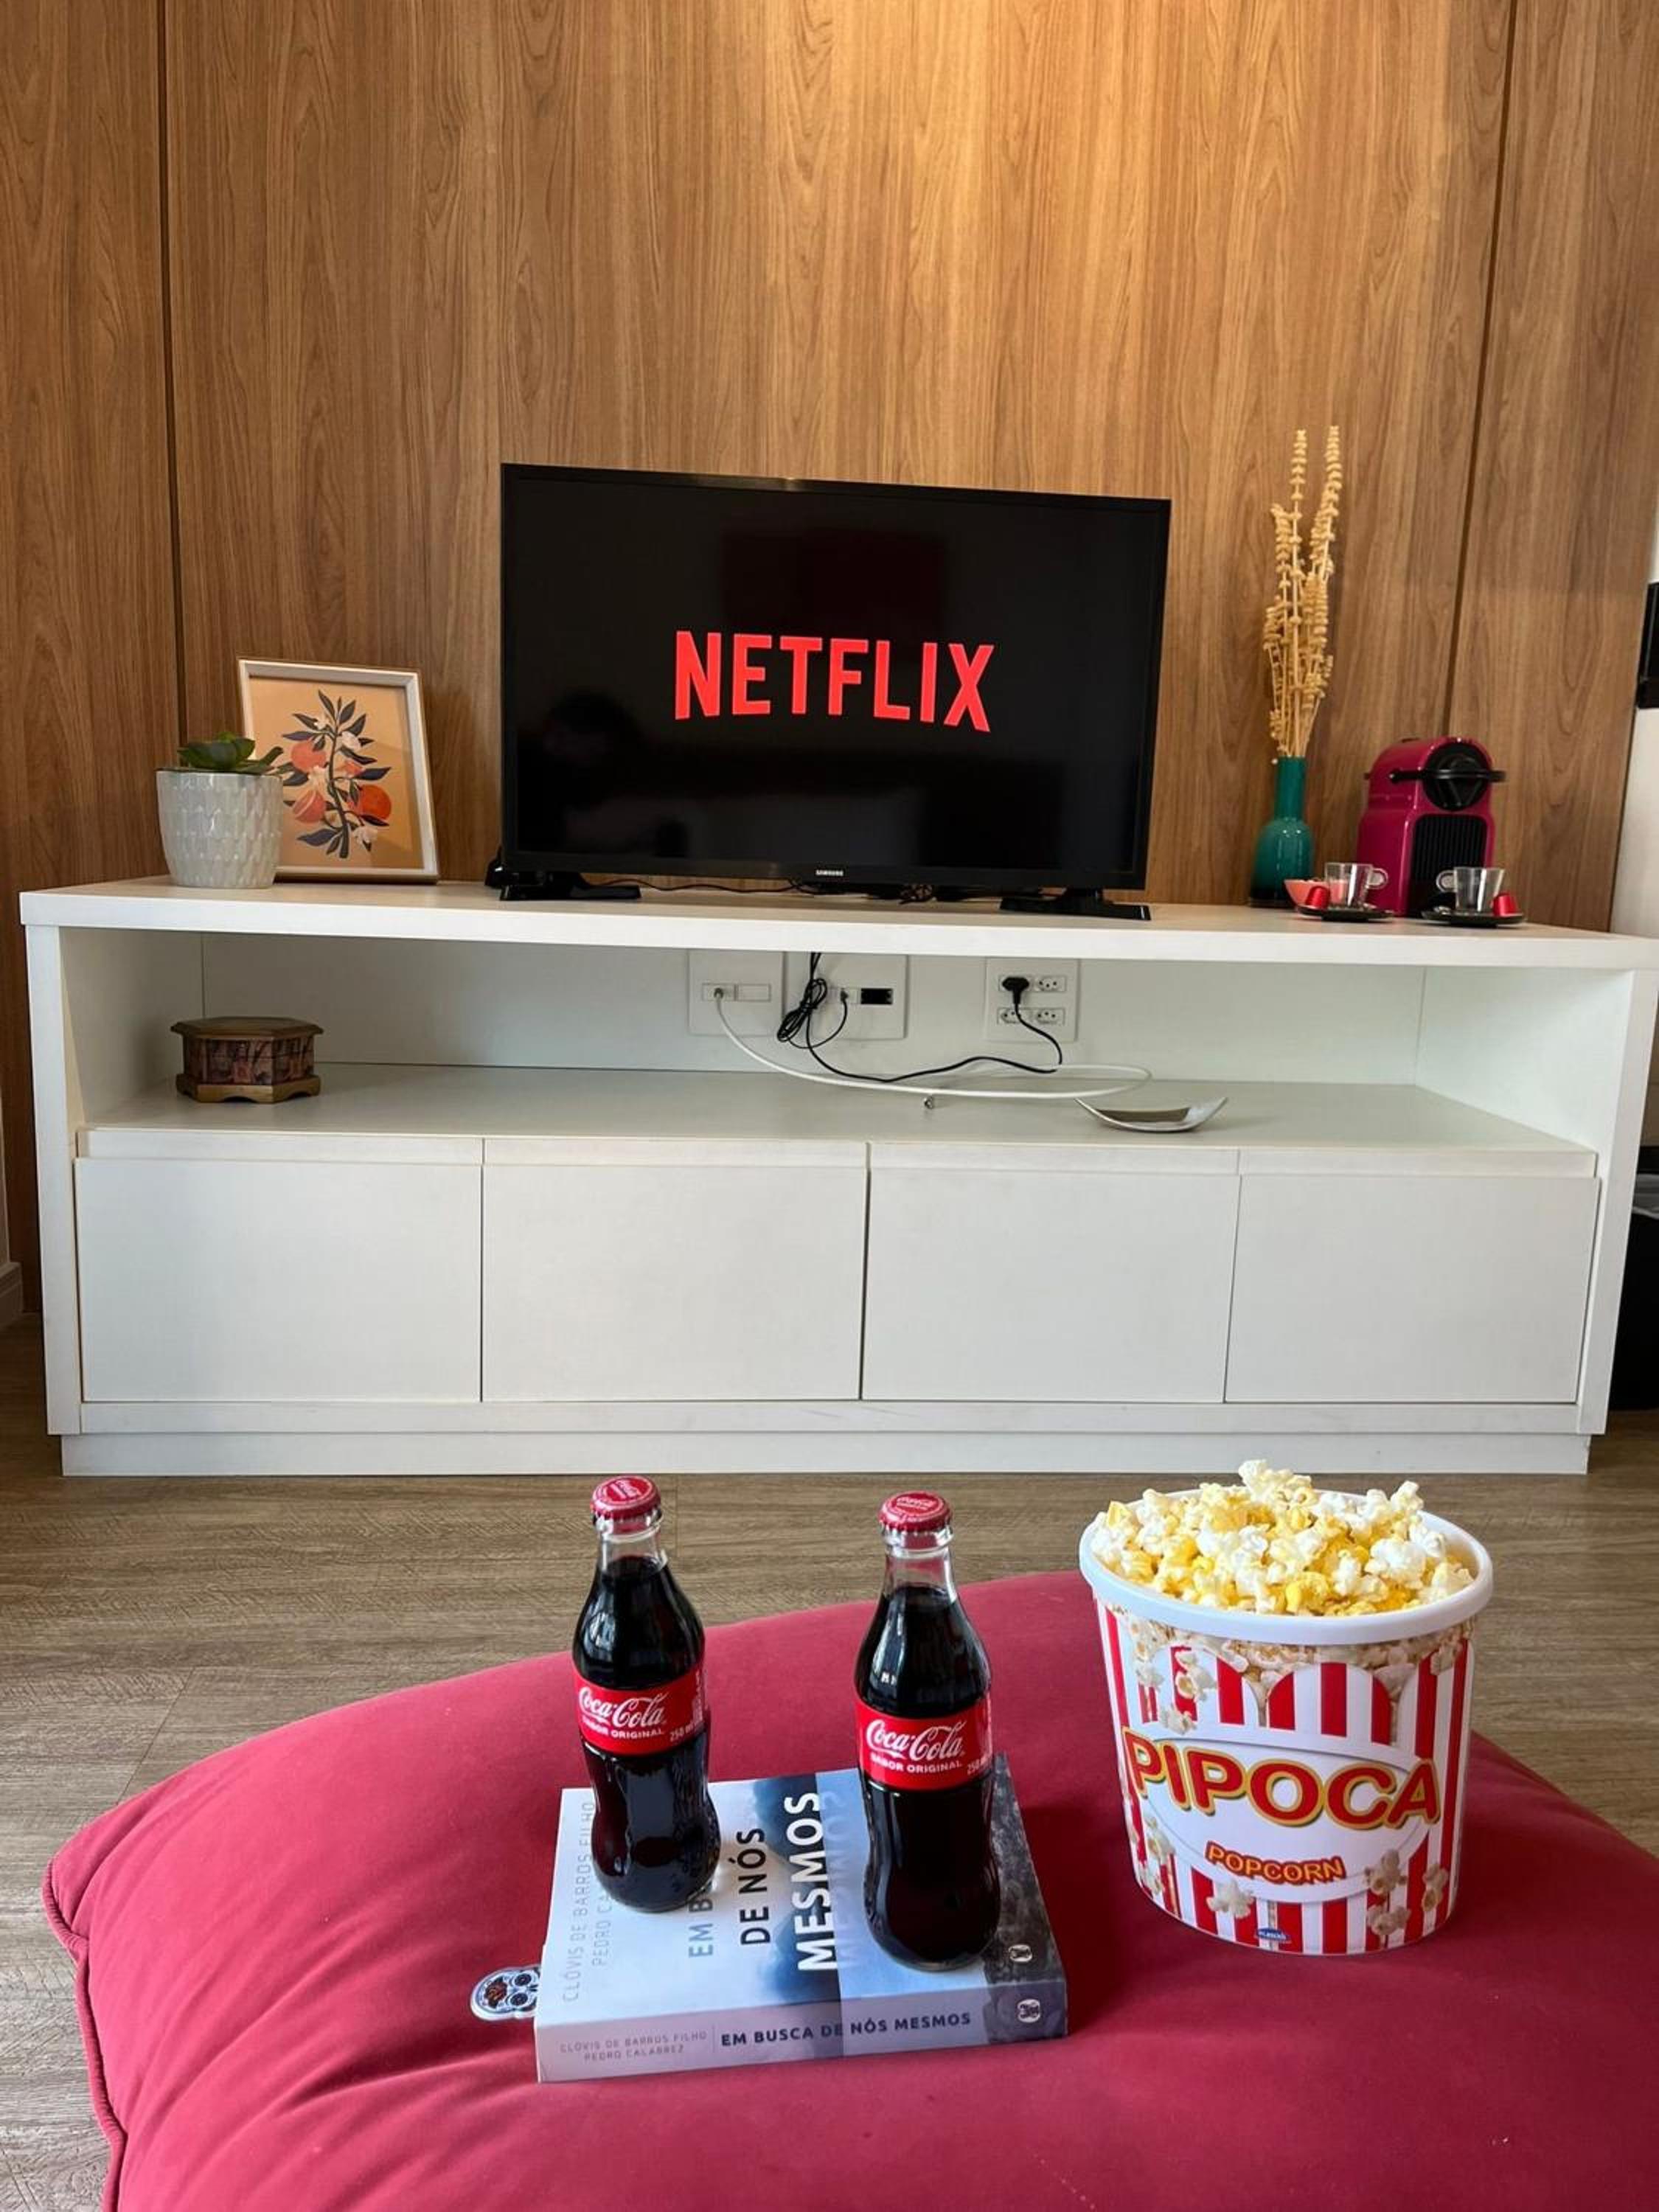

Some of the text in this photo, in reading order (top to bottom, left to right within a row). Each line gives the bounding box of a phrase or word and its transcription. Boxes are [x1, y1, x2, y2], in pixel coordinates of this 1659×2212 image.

[675, 630, 995, 732] NETFLIX
[579, 1687, 669, 1728] Coca-Cola
[611, 1728, 665, 1739] ORIGINAL
[866, 1719, 967, 1761] Coca-Cola
[906, 1760, 962, 1773] ORIGINAL
[1121, 1726, 1441, 1831] PIPOCA
[784, 1792, 838, 1971] MESMOS
[1206, 1842, 1346, 1885] POPCORN
[572, 1853, 592, 1917] BARROS
[728, 1828, 771, 1945] DE NÓS
[570, 1921, 588, 1942] DE
[592, 1920, 612, 1966] PEDRO
[689, 1922, 714, 1958] EM
[563, 1947, 585, 2003] CLÓVIS
[673, 2029, 708, 2042] FILHO
[721, 2011, 972, 2047] EM BUSCA DE NÓS MESMOS
[583, 2044, 685, 2062] PEDRO CALABREZ
